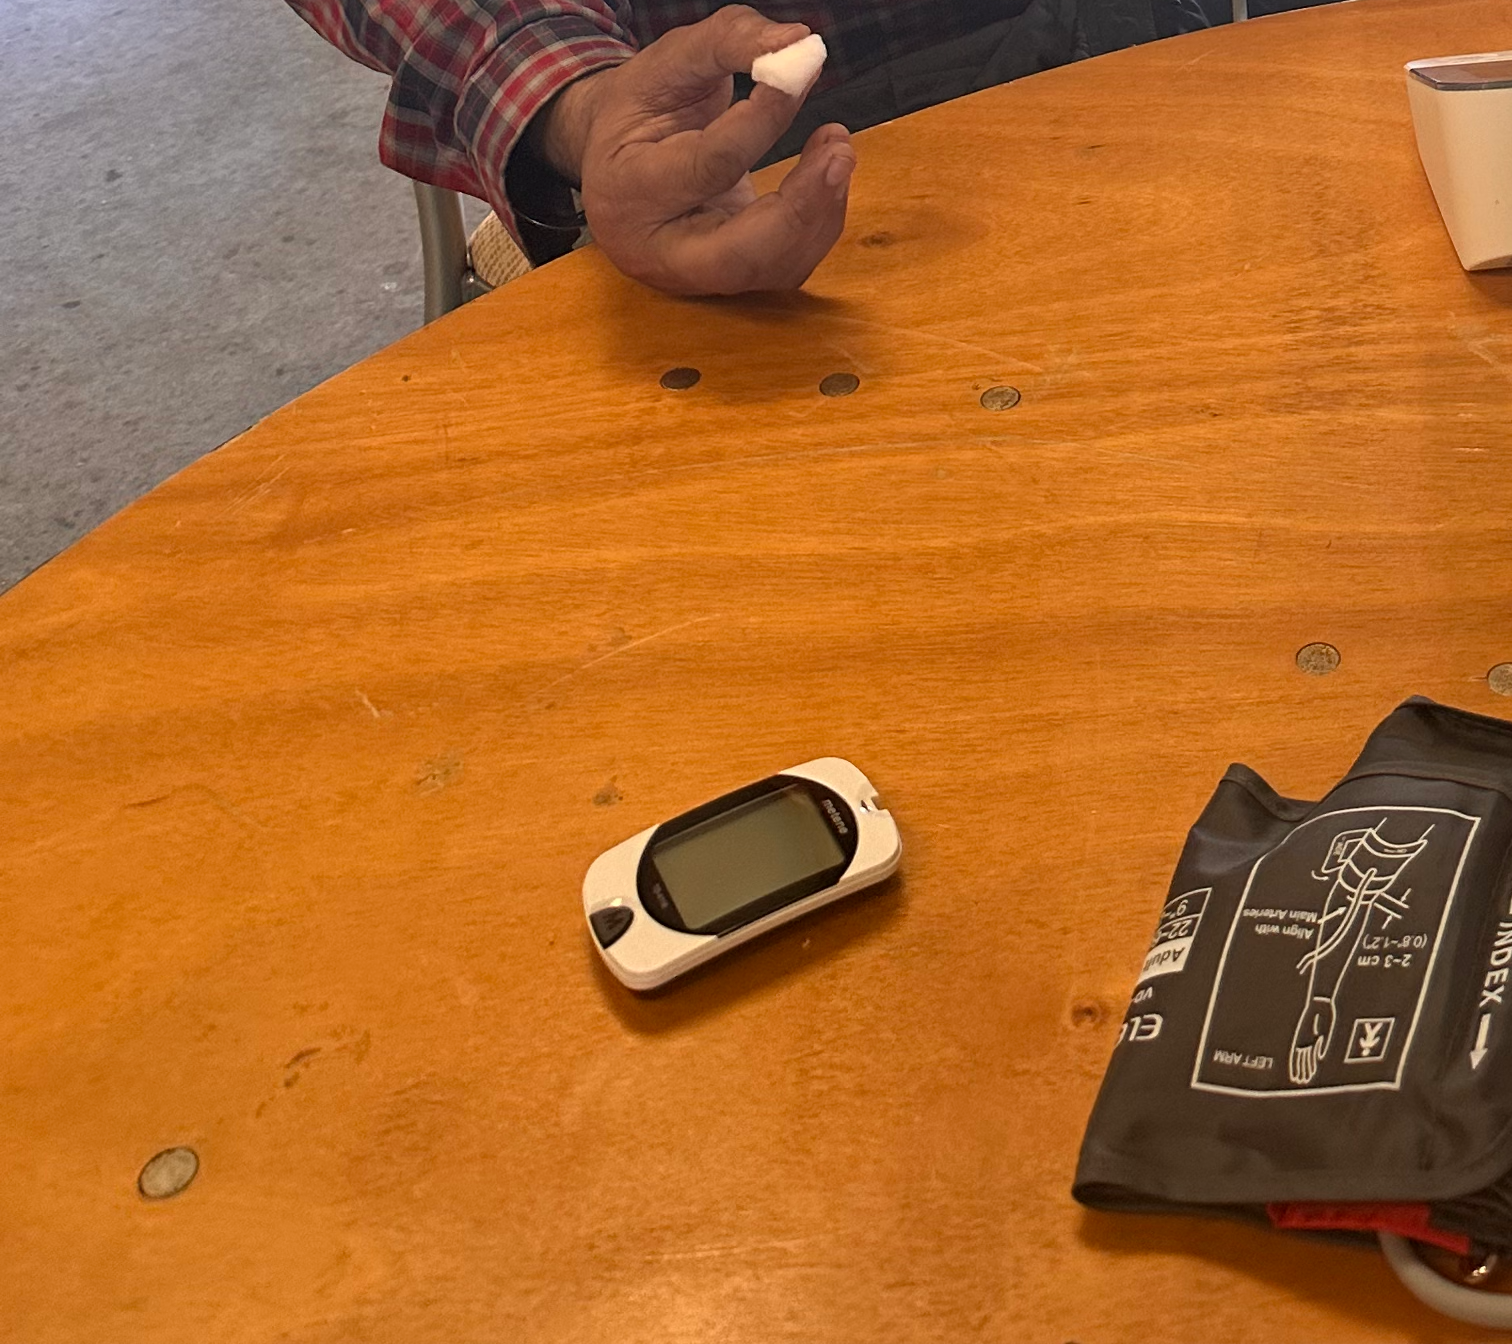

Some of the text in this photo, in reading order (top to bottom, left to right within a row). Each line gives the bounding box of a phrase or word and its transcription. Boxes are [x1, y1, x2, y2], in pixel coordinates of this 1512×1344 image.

[1243, 907, 1317, 922] Main Arteries
[1255, 924, 1314, 939] Align with
[1358, 956, 1380, 966] cm
[1214, 1051, 1273, 1069] LEFT ARM
